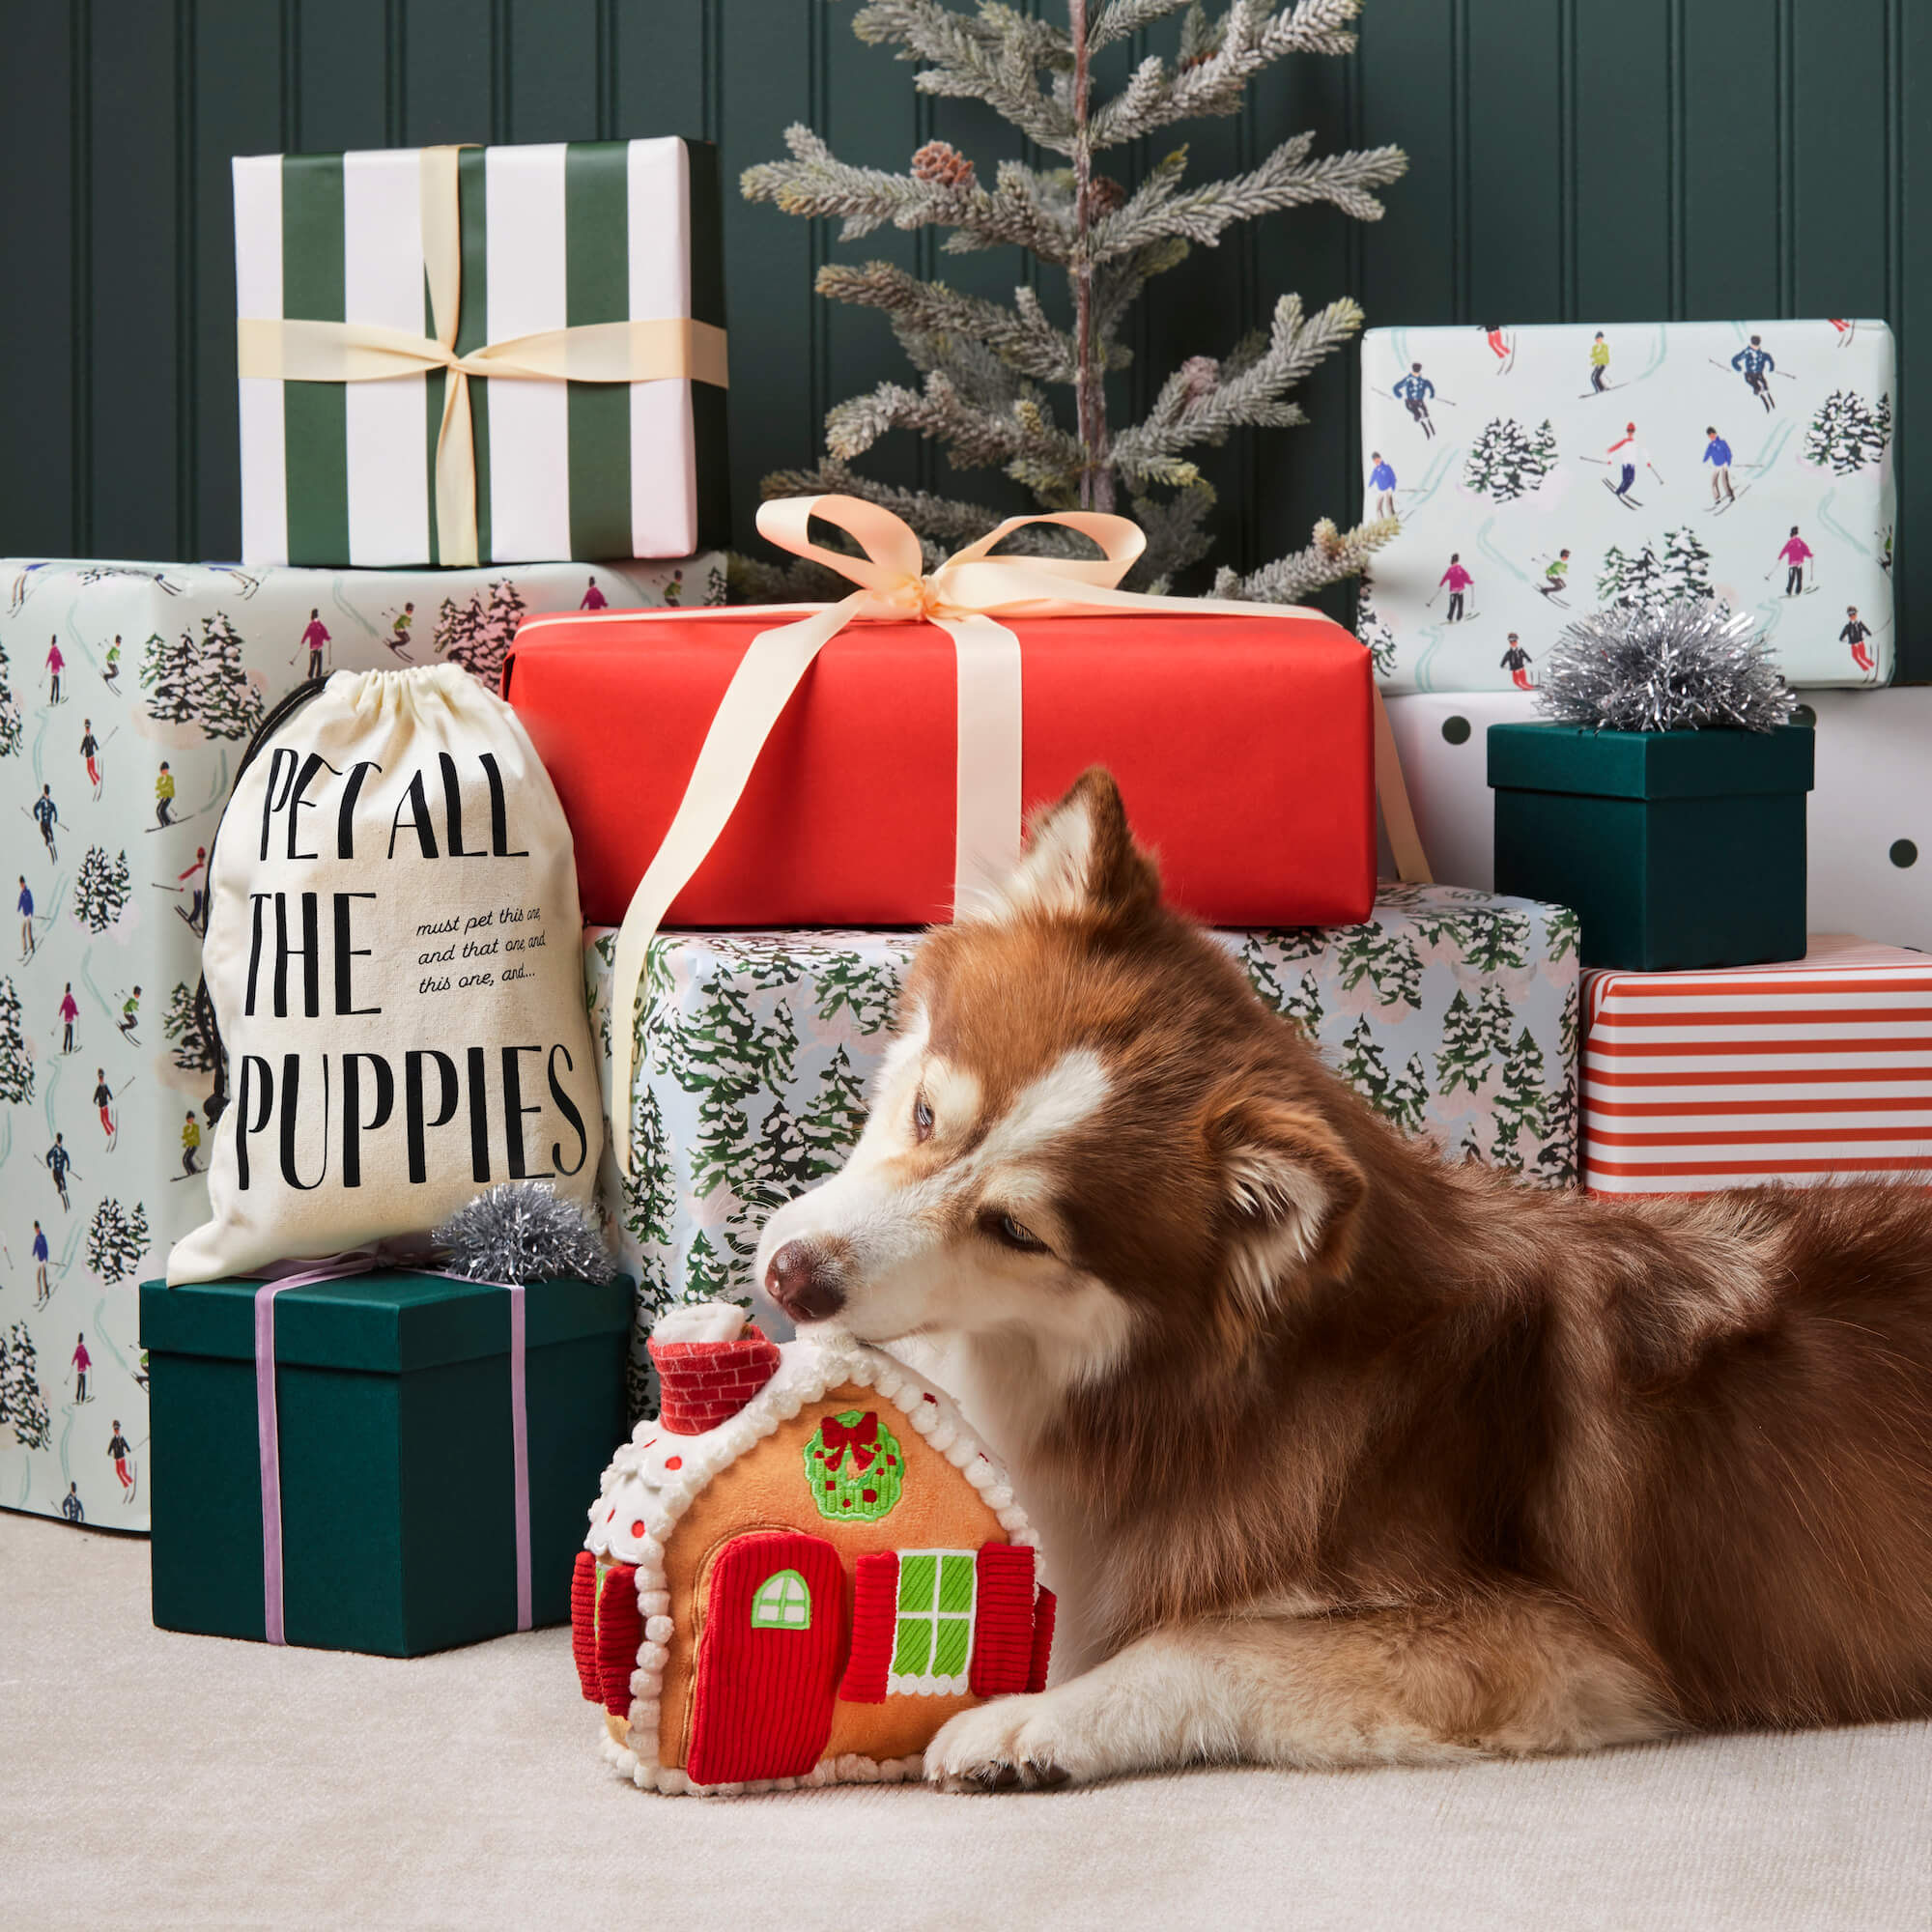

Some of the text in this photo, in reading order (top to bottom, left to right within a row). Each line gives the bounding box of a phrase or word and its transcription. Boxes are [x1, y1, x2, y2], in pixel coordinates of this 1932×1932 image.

[259, 748, 529, 862] PET ALL
[244, 892, 383, 1018] THE
[415, 915, 461, 936] must
[464, 911, 494, 936] pet
[499, 907, 525, 923] this
[418, 944, 456, 965] and
[462, 938, 499, 958] that
[527, 930, 547, 949] and
[418, 976, 452, 994] this
[458, 973, 495, 987] one,
[236, 1043, 587, 1191] PUPPIES
